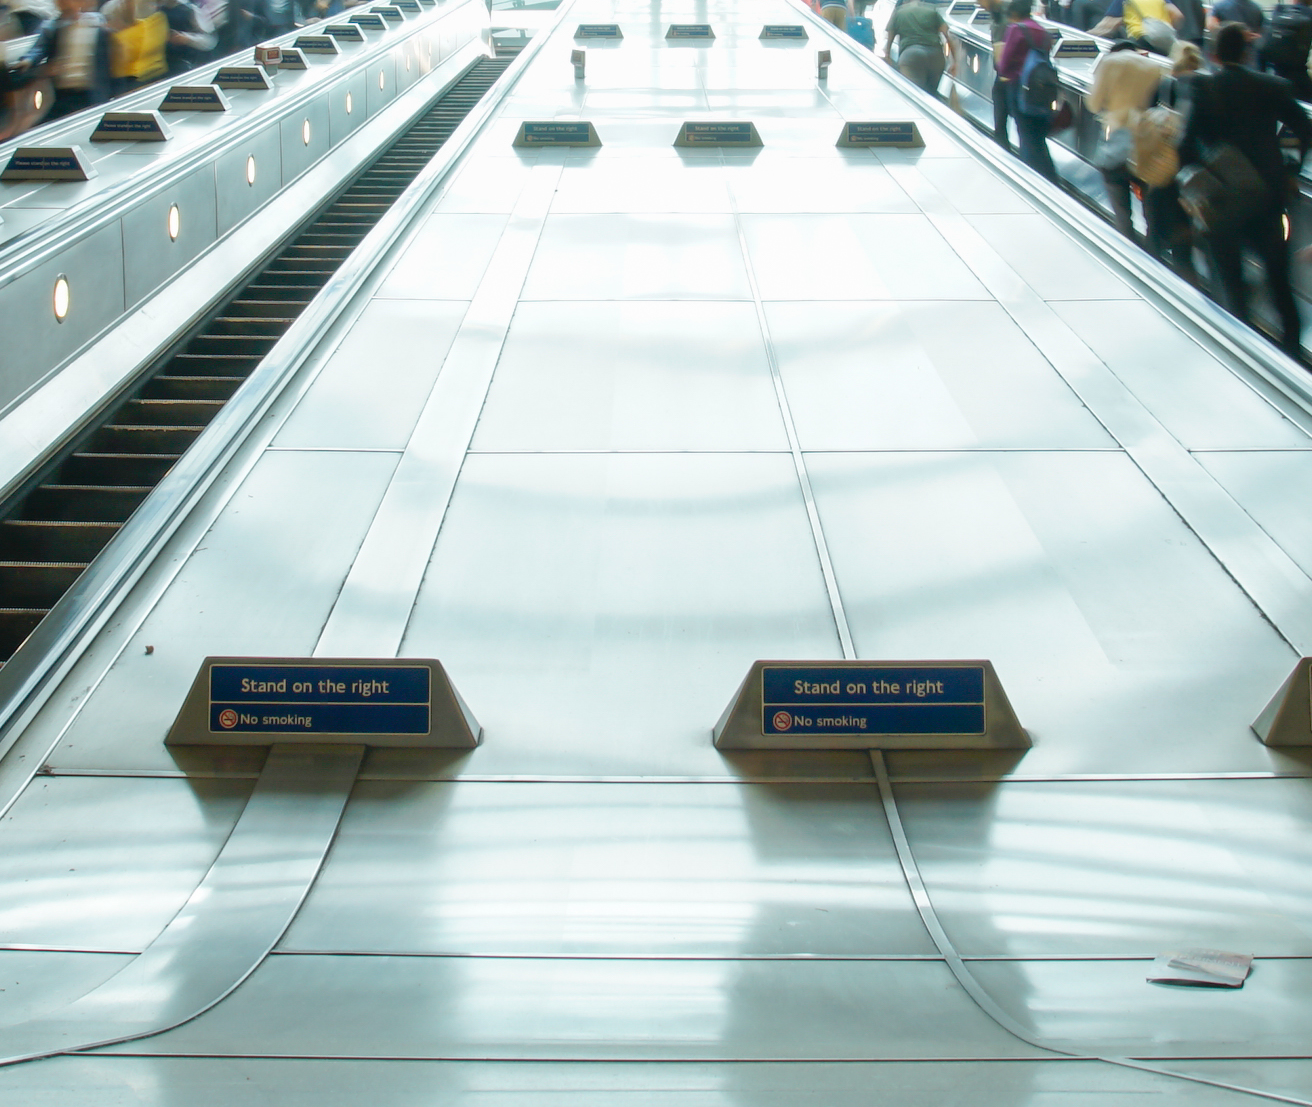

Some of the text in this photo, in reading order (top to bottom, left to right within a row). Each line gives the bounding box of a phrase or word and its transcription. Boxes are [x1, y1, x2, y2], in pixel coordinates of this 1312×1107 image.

[241, 678, 389, 697] Stand on the right
[794, 680, 944, 697] Stand on the right
[240, 714, 312, 727] No smoking
[794, 716, 867, 729] No smoking
